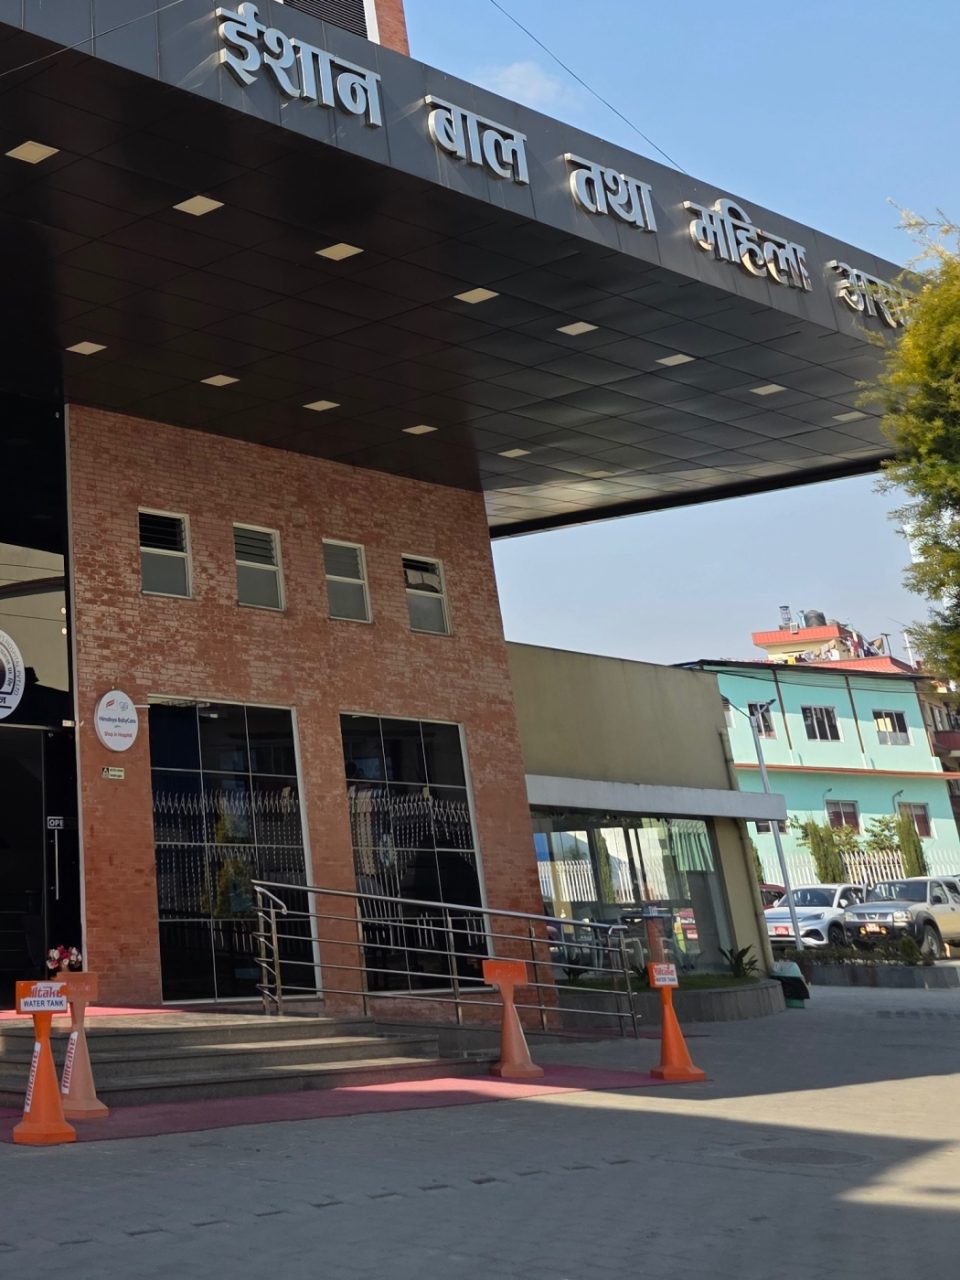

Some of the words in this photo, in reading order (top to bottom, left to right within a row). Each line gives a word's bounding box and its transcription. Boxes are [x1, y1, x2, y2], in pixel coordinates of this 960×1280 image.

[215, 1, 382, 128] ईशान
[424, 94, 530, 186] बाल
[564, 152, 658, 233] तथा
[682, 197, 813, 292] महिला
[24, 1000, 45, 1008] WATER
[47, 1000, 64, 1008] TANK
